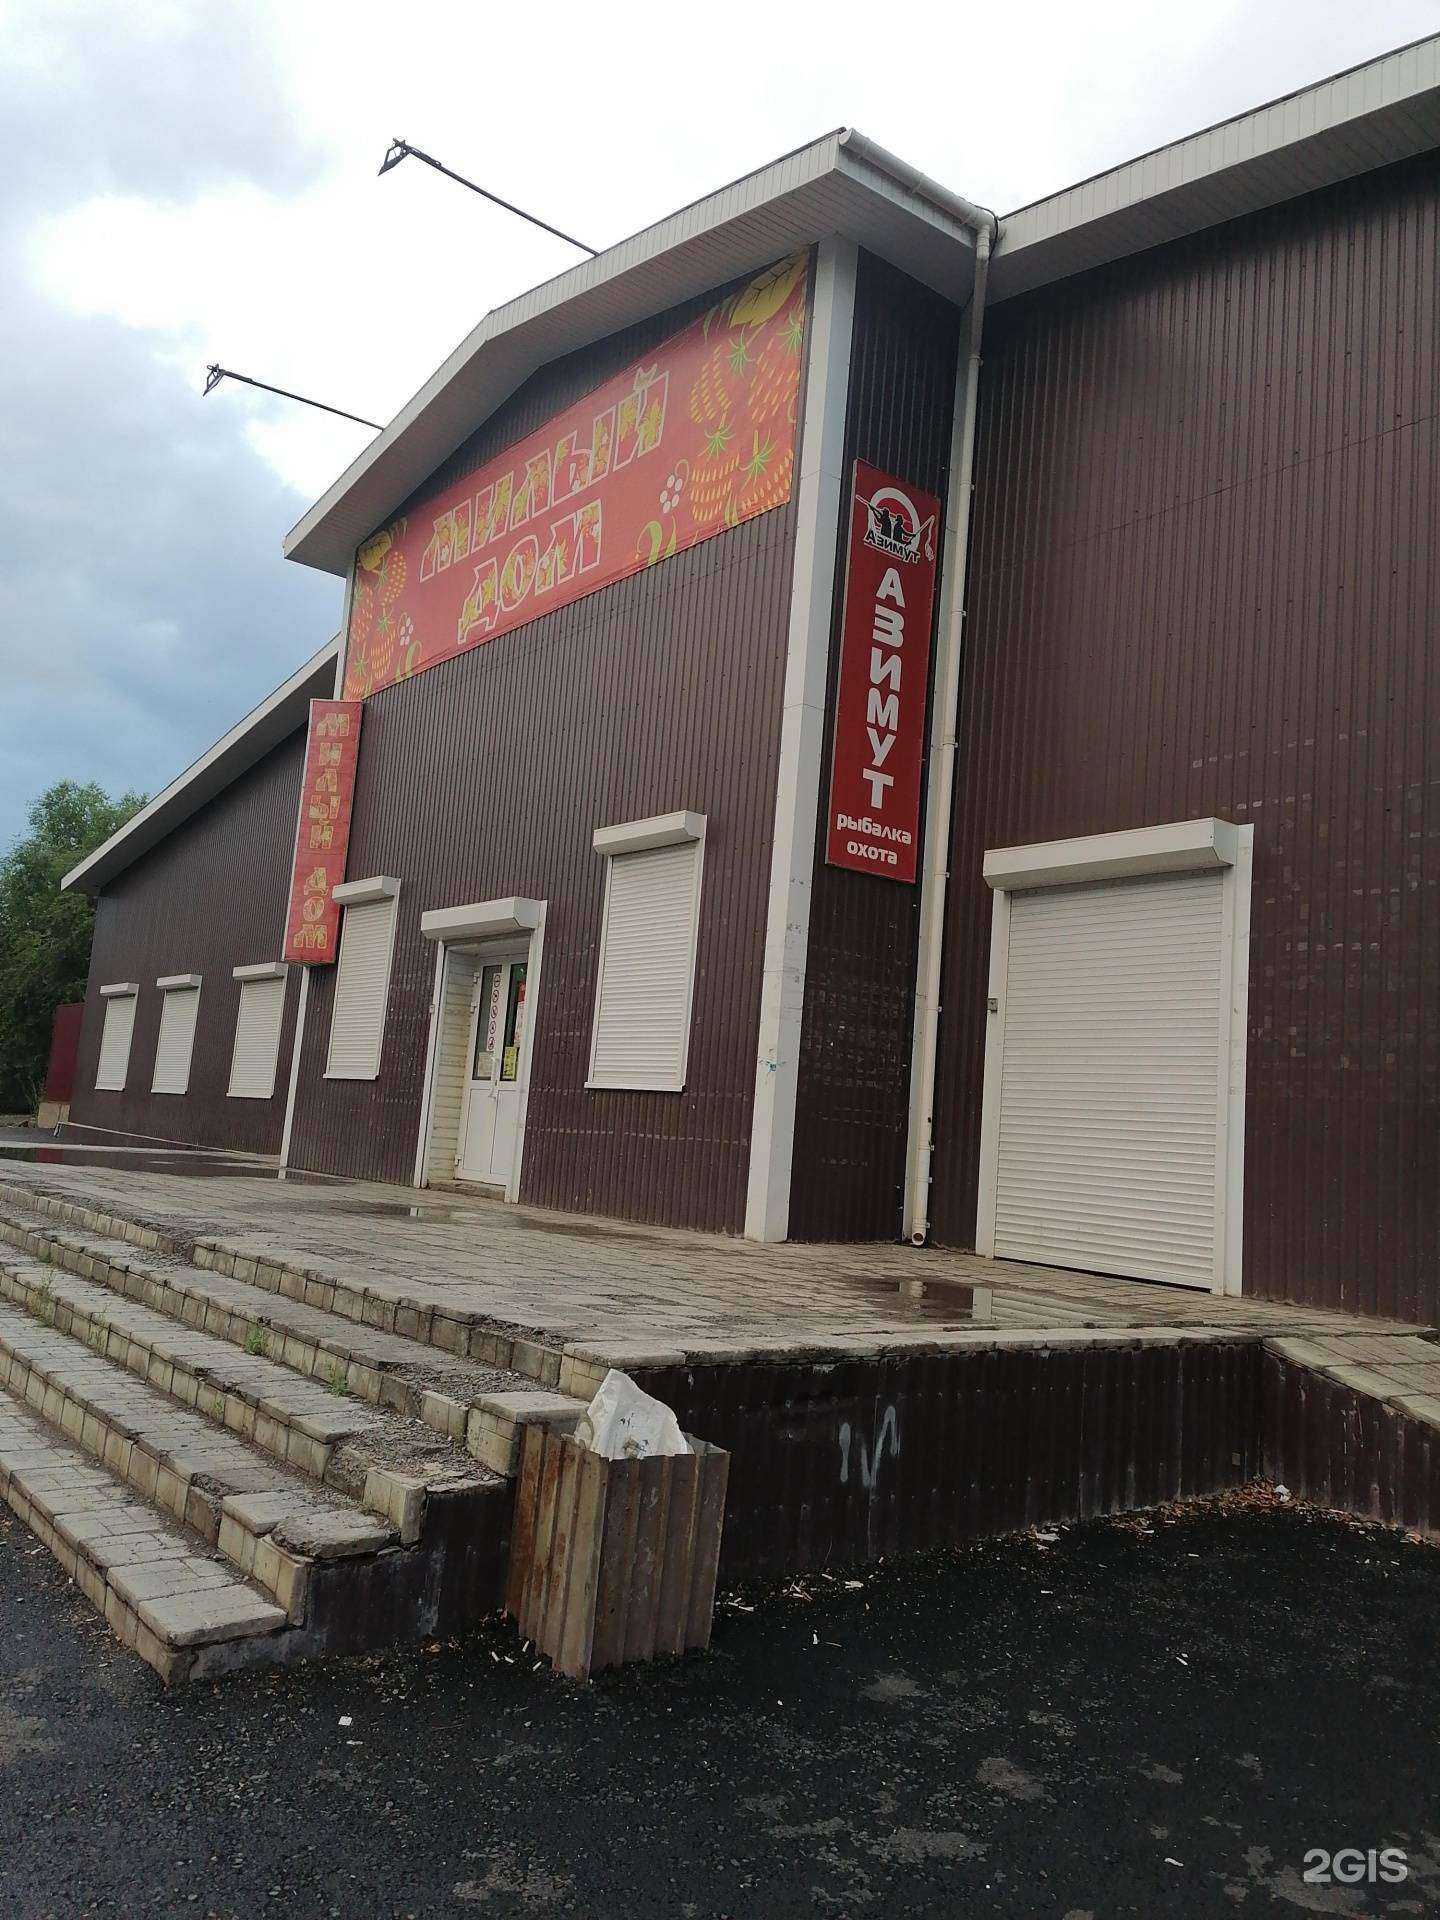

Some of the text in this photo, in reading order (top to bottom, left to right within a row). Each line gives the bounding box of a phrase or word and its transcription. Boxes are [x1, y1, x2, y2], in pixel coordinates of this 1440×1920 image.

[419, 364, 669, 583] МИЛЫЙ
[457, 499, 602, 645] ДОМ
[864, 529, 920, 564] АЗИМУТ
[862, 567, 906, 810] АЗИМУТ
[308, 713, 350, 849] МИЛЫЙ
[836, 813, 912, 845] рыбалка
[846, 841, 898, 865] охота
[293, 867, 327, 949] ДОМ
